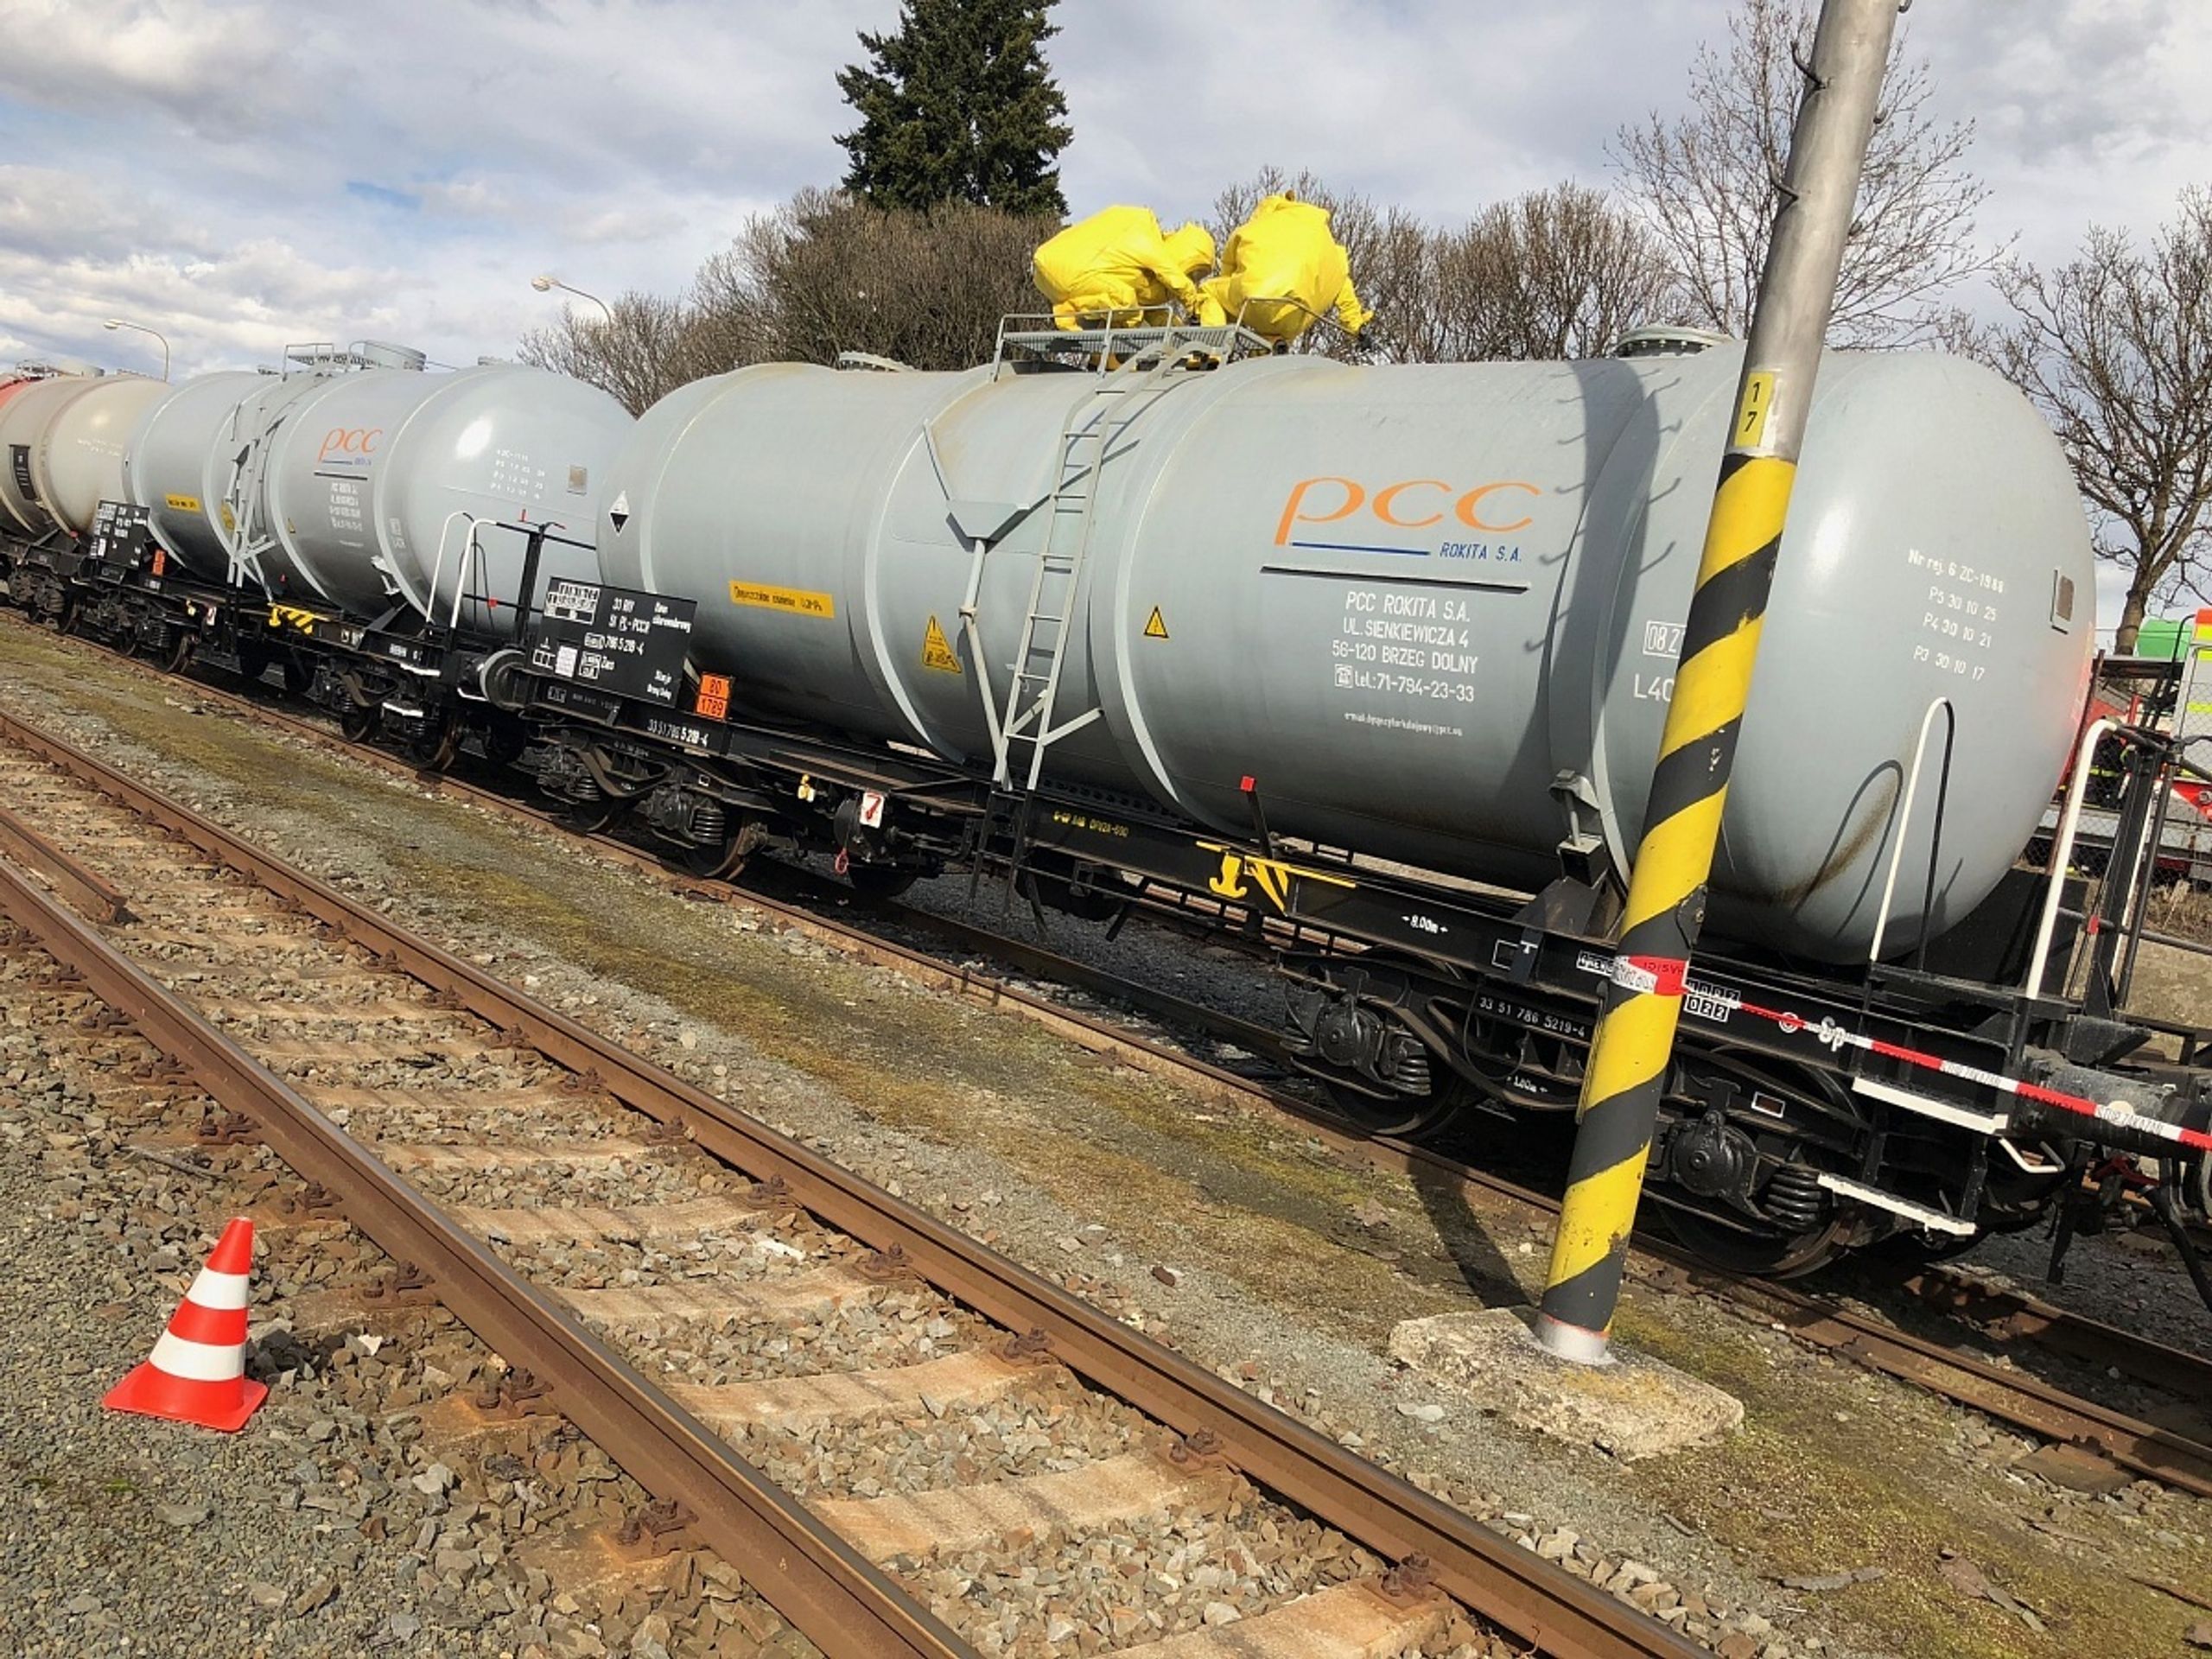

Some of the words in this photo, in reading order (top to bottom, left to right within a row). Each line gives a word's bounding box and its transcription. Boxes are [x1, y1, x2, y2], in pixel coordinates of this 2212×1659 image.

[1440, 542, 1488, 560] ROKITA
[1496, 545, 1522, 562] S.A.
[1908, 548, 1925, 566] Nr
[1948, 562, 1957, 576] 6
[1345, 591, 1376, 613] PCC
[1382, 594, 1437, 619] ROKITA
[1442, 600, 1471, 622] S.A.
[1928, 586, 1945, 604] P5
[1948, 594, 1962, 610] 30
[1966, 601, 1979, 615] 10
[1983, 606, 1997, 621] 25
[1458, 629, 1469, 648] 4
[1647, 625, 1686, 654] 08.2
[1923, 612, 1940, 631] P4
[1941, 619, 1958, 637] 30
[1962, 626, 1974, 641] 10
[1979, 632, 1992, 648] 21
[1332, 639, 1376, 662] 56-120
[1382, 646, 1425, 667] BRZEG
[1432, 651, 1478, 674] DOLNY
[1913, 645, 1929, 661] P3
[1936, 652, 1950, 669] 30
[1954, 659, 1967, 674] 10
[1972, 665, 1986, 682] 17
[702, 698, 723, 716] 1789
[1479, 996, 1493, 1010] 33
[1497, 1002, 1511, 1015] 51
[1516, 1007, 1539, 1024] 786
[1543, 1015, 1585, 1037] 5219-4
